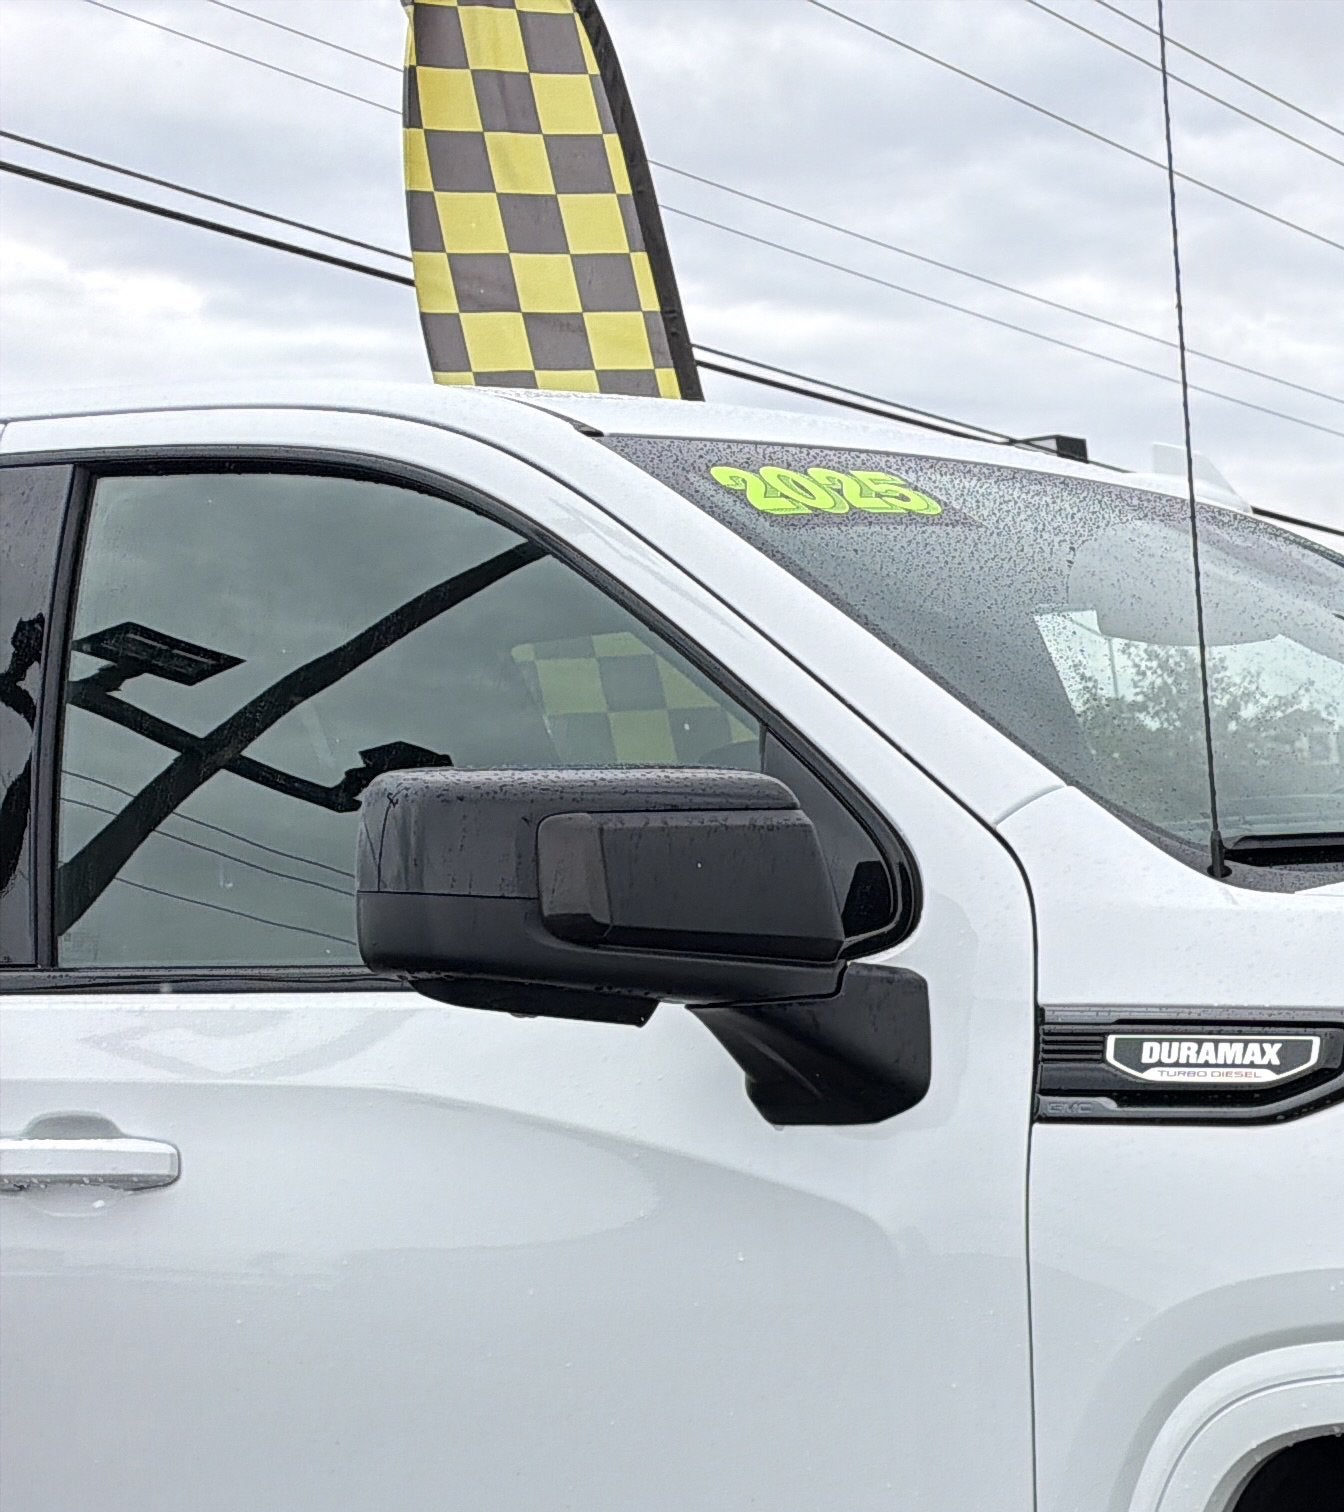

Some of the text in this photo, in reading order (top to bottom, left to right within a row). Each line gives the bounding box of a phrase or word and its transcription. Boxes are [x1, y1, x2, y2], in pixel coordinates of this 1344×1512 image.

[710, 465, 943, 516] 2025
[1141, 1041, 1283, 1066] DURAMAX
[1157, 1069, 1263, 1079] TURBO DIESEL
[1047, 1102, 1092, 1114] GMC
